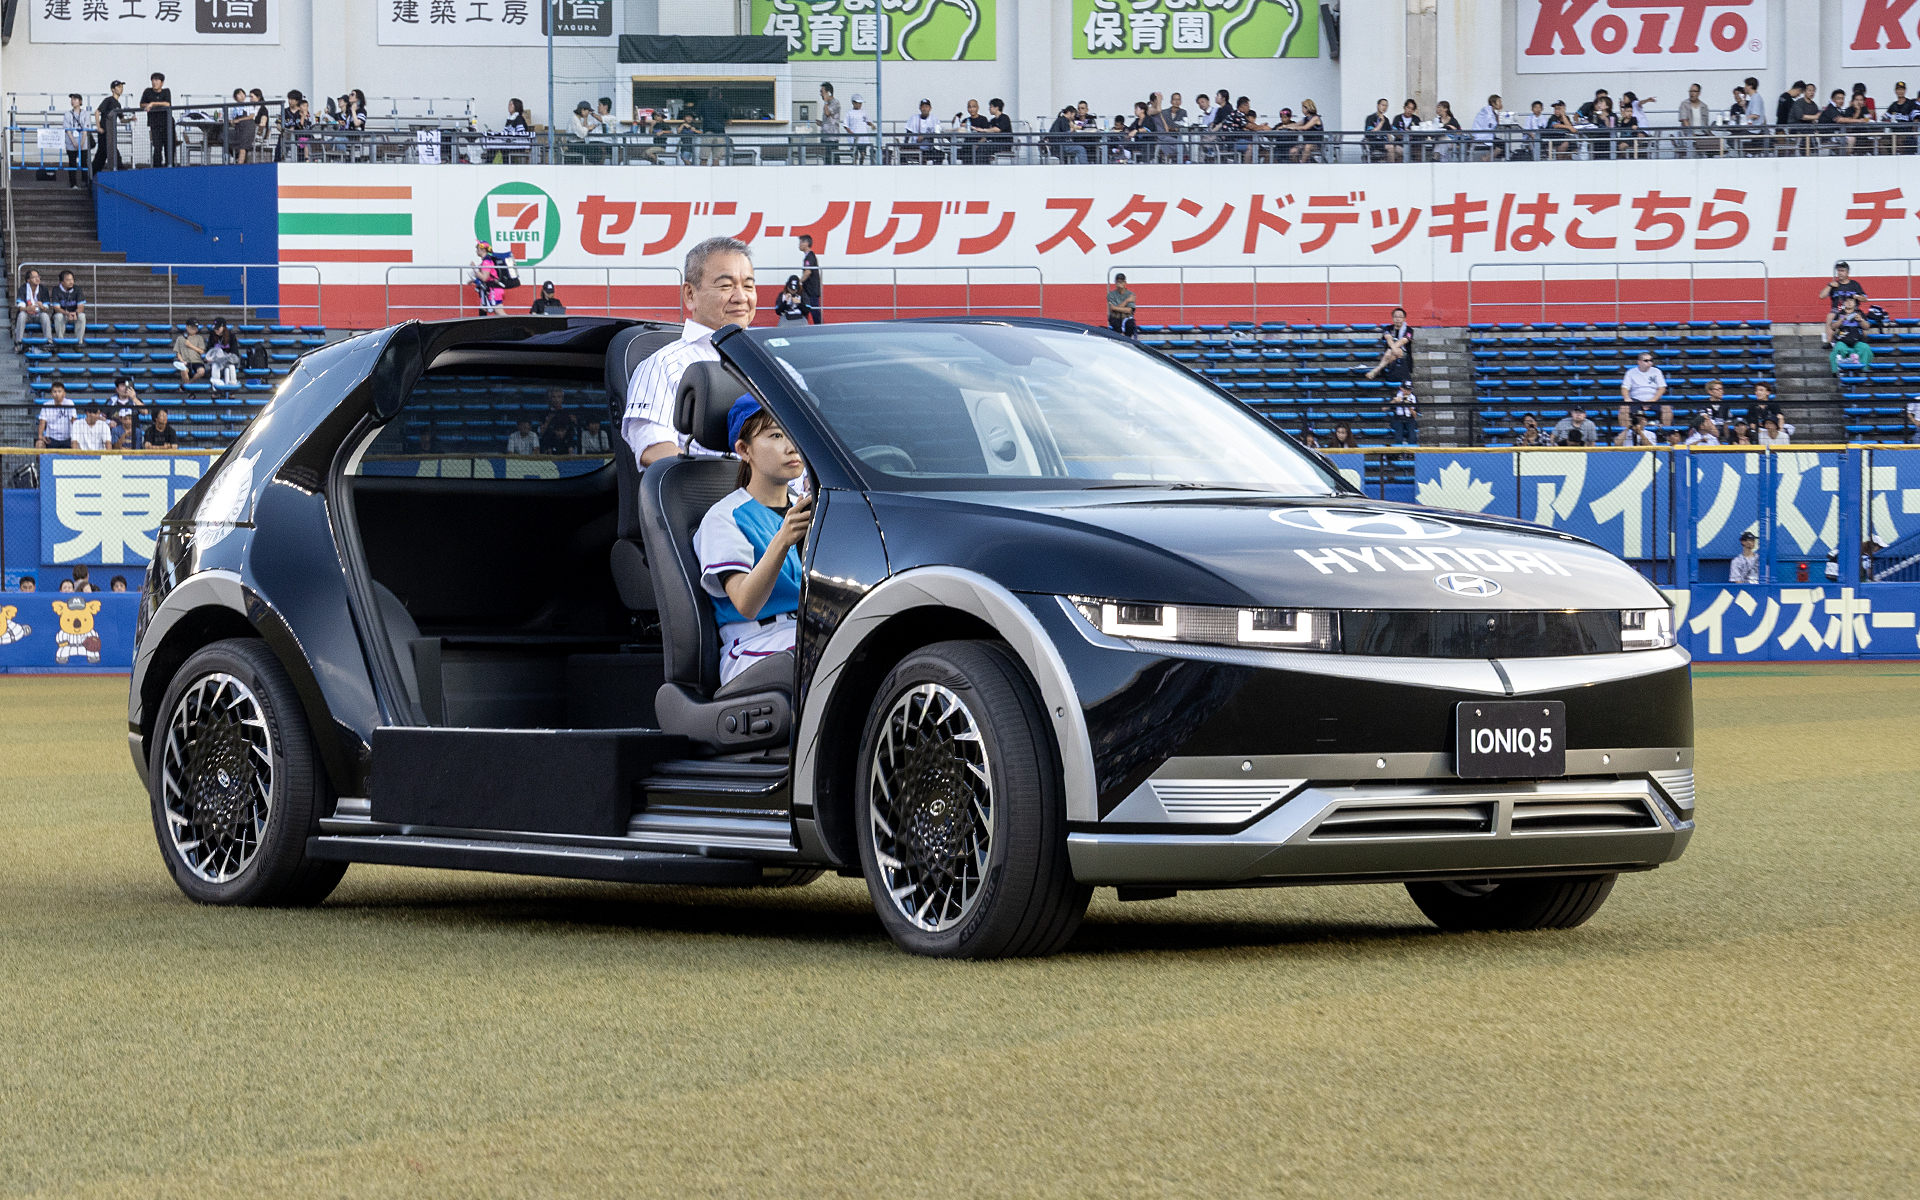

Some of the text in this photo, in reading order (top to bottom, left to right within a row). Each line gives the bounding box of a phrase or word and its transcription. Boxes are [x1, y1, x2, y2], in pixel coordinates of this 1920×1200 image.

[211, 21, 252, 29] YAGURA
[391, 0, 529, 25] 建築工房
[1083, 11, 1211, 51] 保育園
[1849, 0, 1920, 50] K
[763, 13, 889, 52] 保育園
[1844, 187, 1920, 248] チ
[1293, 546, 1572, 577] HYUNDAI
[1660, 586, 1920, 654] インズホー
[1470, 727, 1552, 757] IONIQ 5
[961, 878, 996, 941] DUNLOP
